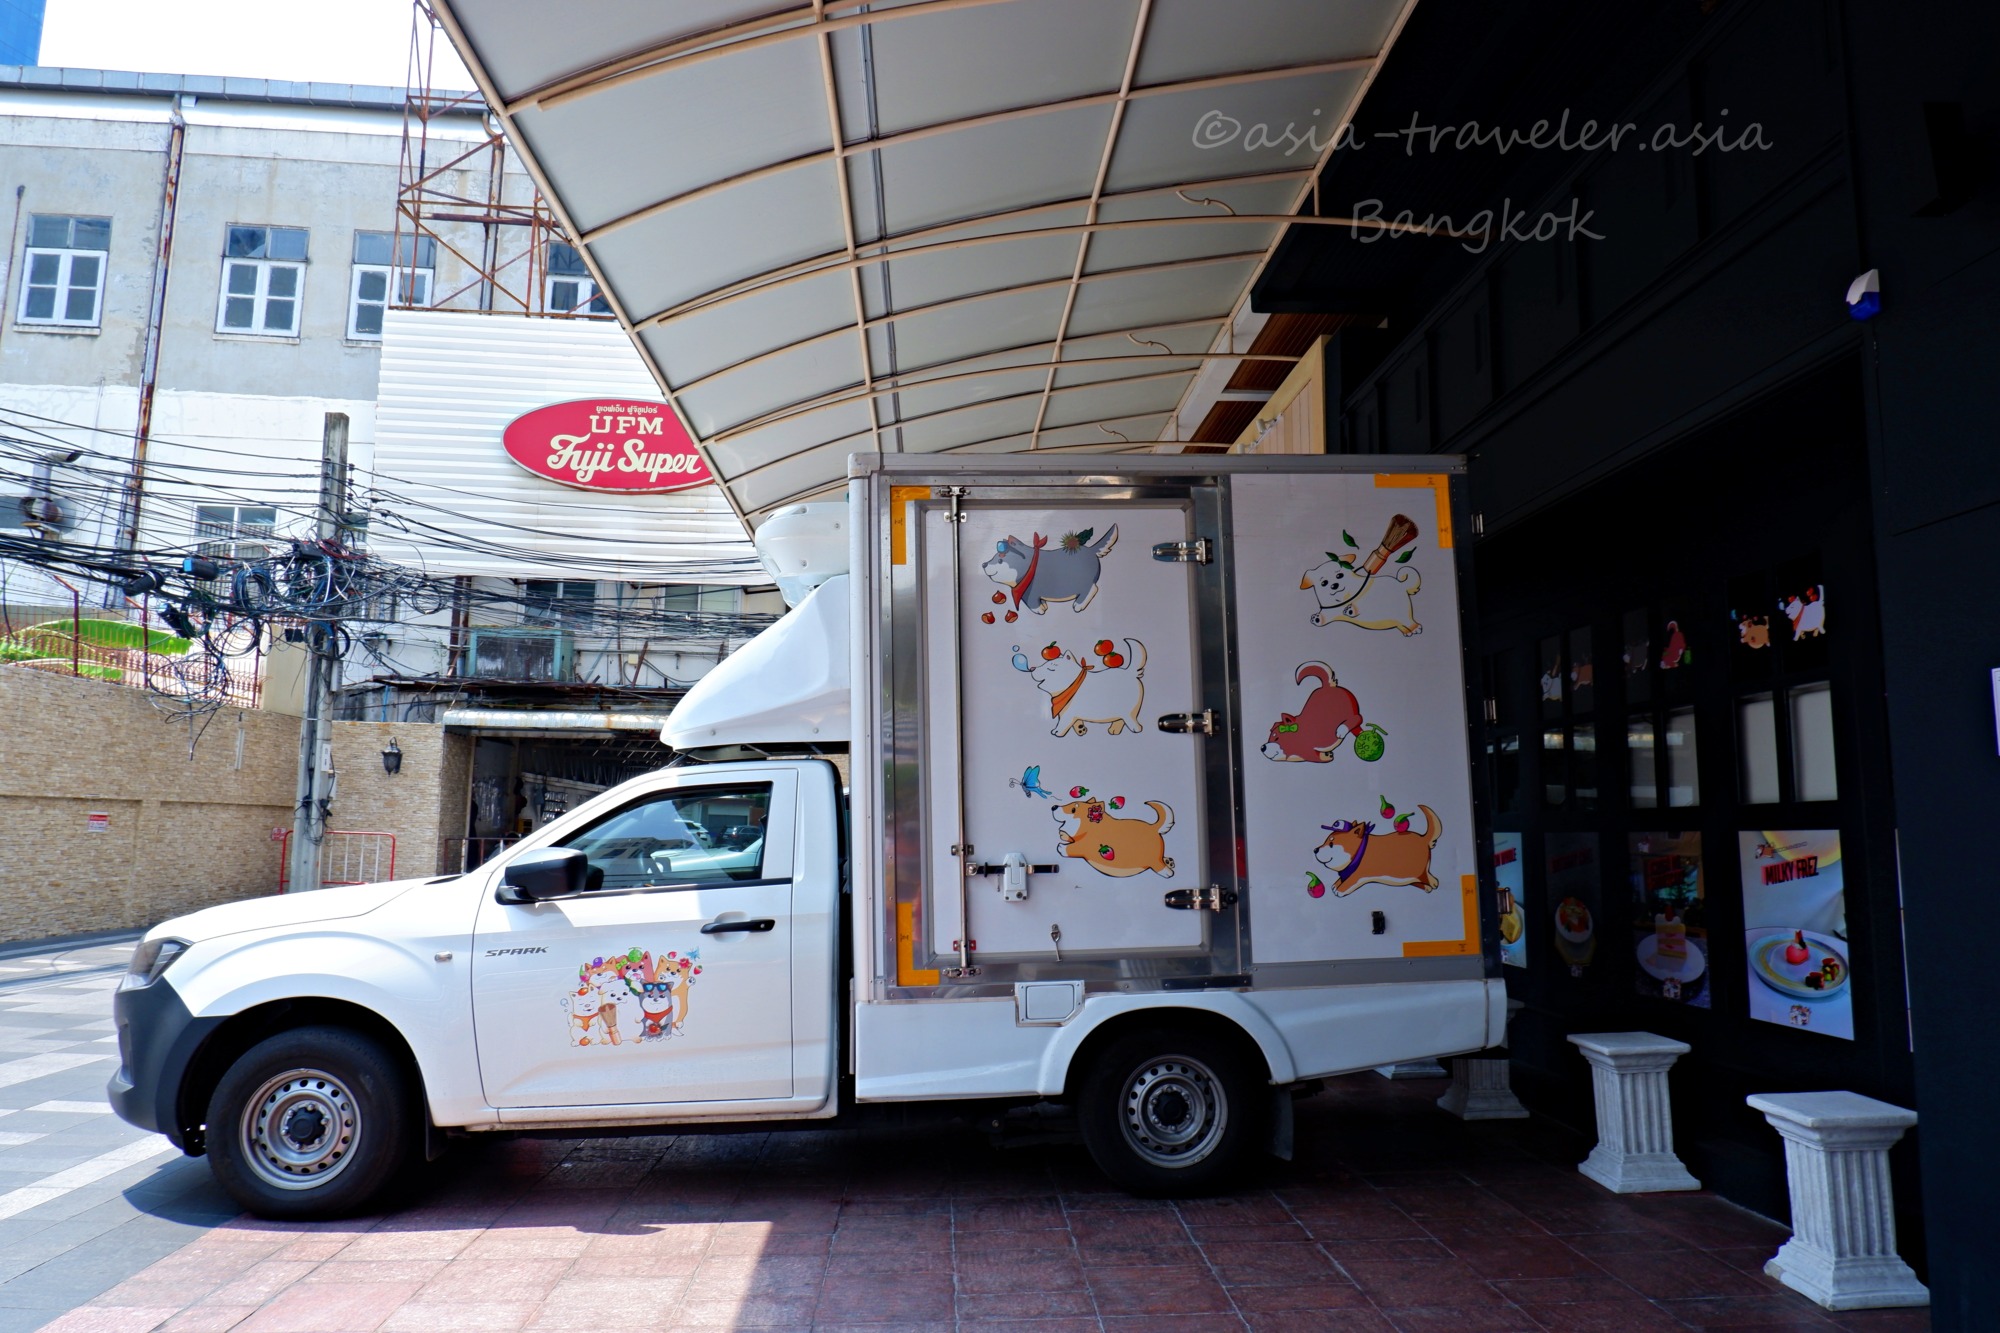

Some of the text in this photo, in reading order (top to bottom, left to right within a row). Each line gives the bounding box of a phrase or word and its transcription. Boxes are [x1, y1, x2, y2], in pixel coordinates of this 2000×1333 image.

[589, 415, 664, 435] UFM
[546, 432, 702, 483] Fuji Super
[1764, 856, 1819, 885] MILKY FREZ
[485, 946, 549, 957] SPARK
